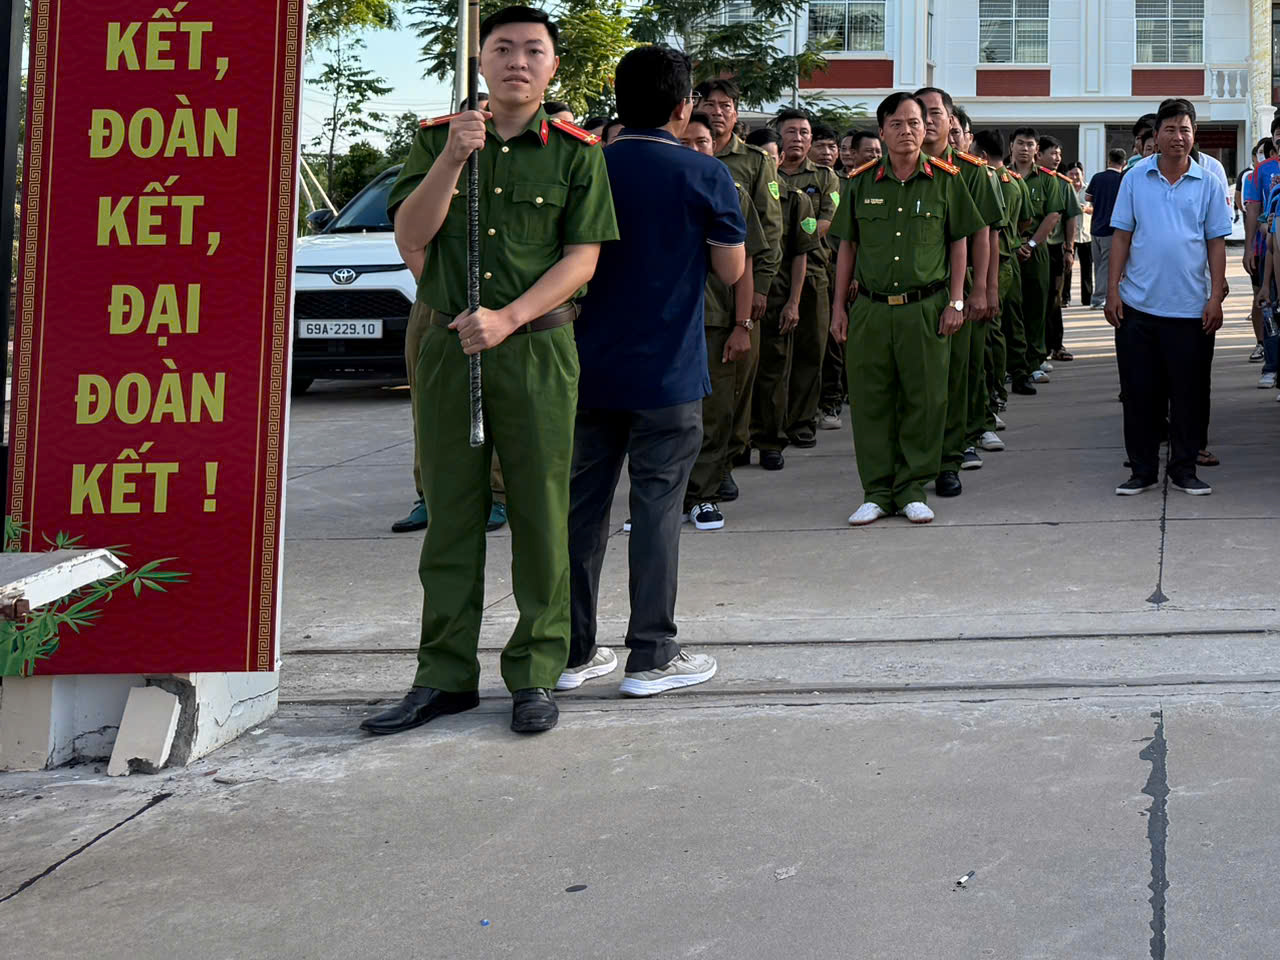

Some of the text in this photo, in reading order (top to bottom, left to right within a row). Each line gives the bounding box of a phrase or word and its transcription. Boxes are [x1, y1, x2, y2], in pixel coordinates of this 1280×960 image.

[105, 2, 230, 81] KẾT,
[88, 95, 239, 159] ĐOÀN
[96, 175, 221, 255] KẾT,
[108, 283, 202, 347] ĐẠI
[306, 323, 375, 335] 69A-229.10
[74, 359, 226, 425] ĐOÀN
[70, 441, 219, 515] KẾT !
